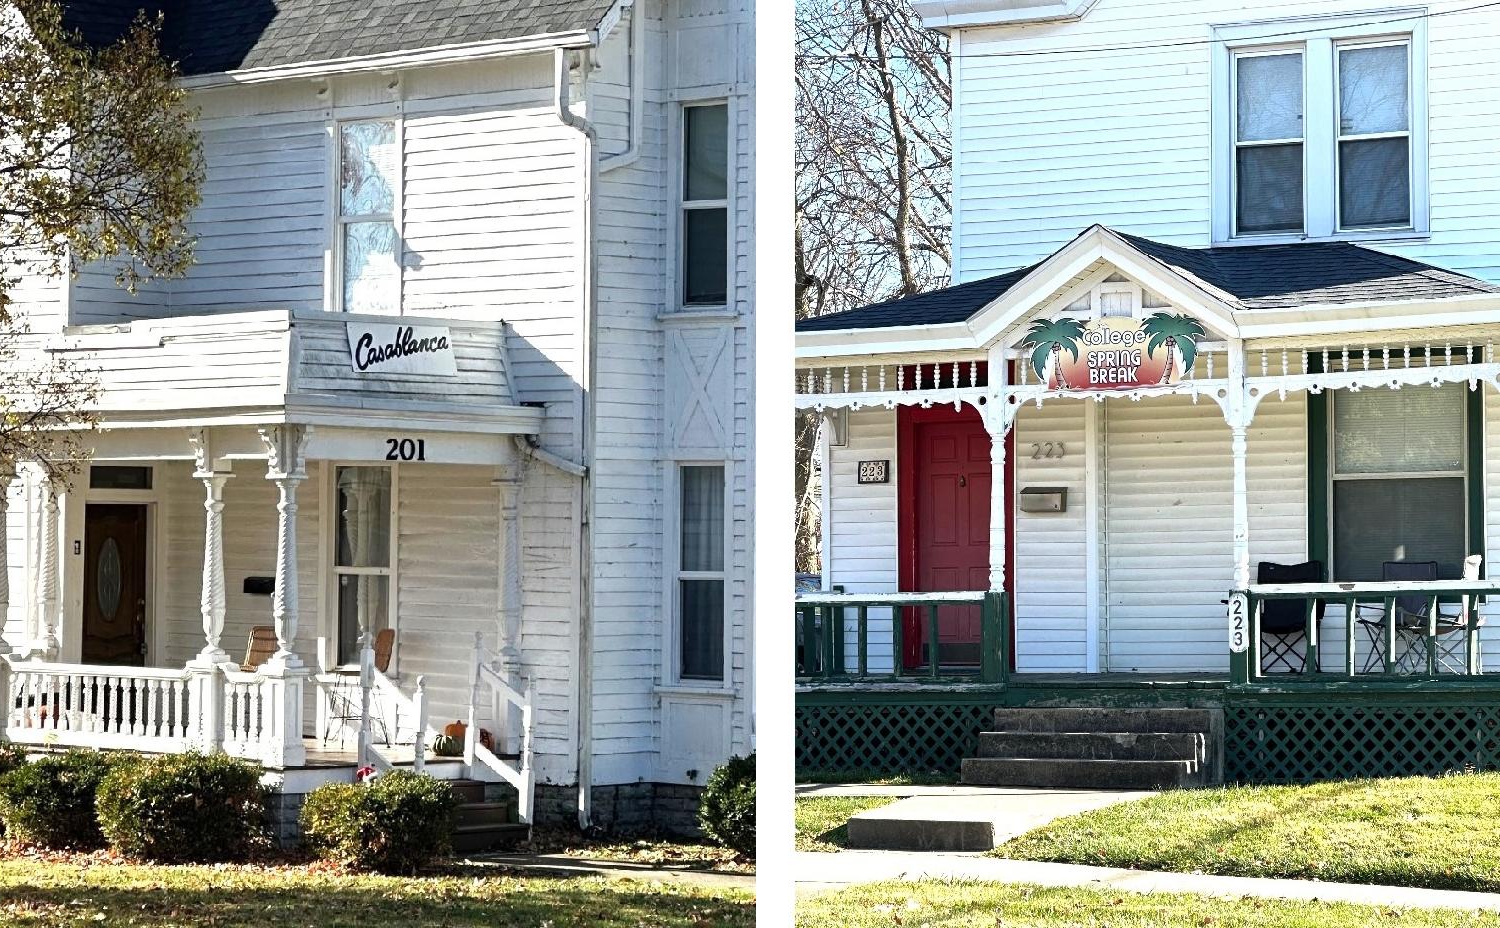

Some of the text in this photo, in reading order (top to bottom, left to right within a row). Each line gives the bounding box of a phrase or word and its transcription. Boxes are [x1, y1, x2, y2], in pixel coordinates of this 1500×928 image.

[355, 327, 449, 370] Casablanca
[1087, 350, 1142, 368] SPRING
[1089, 366, 1139, 384] BREAK
[386, 438, 426, 461] 201
[1031, 442, 1066, 460] 223
[861, 465, 884, 477] 223
[1232, 599, 1244, 647] 223
